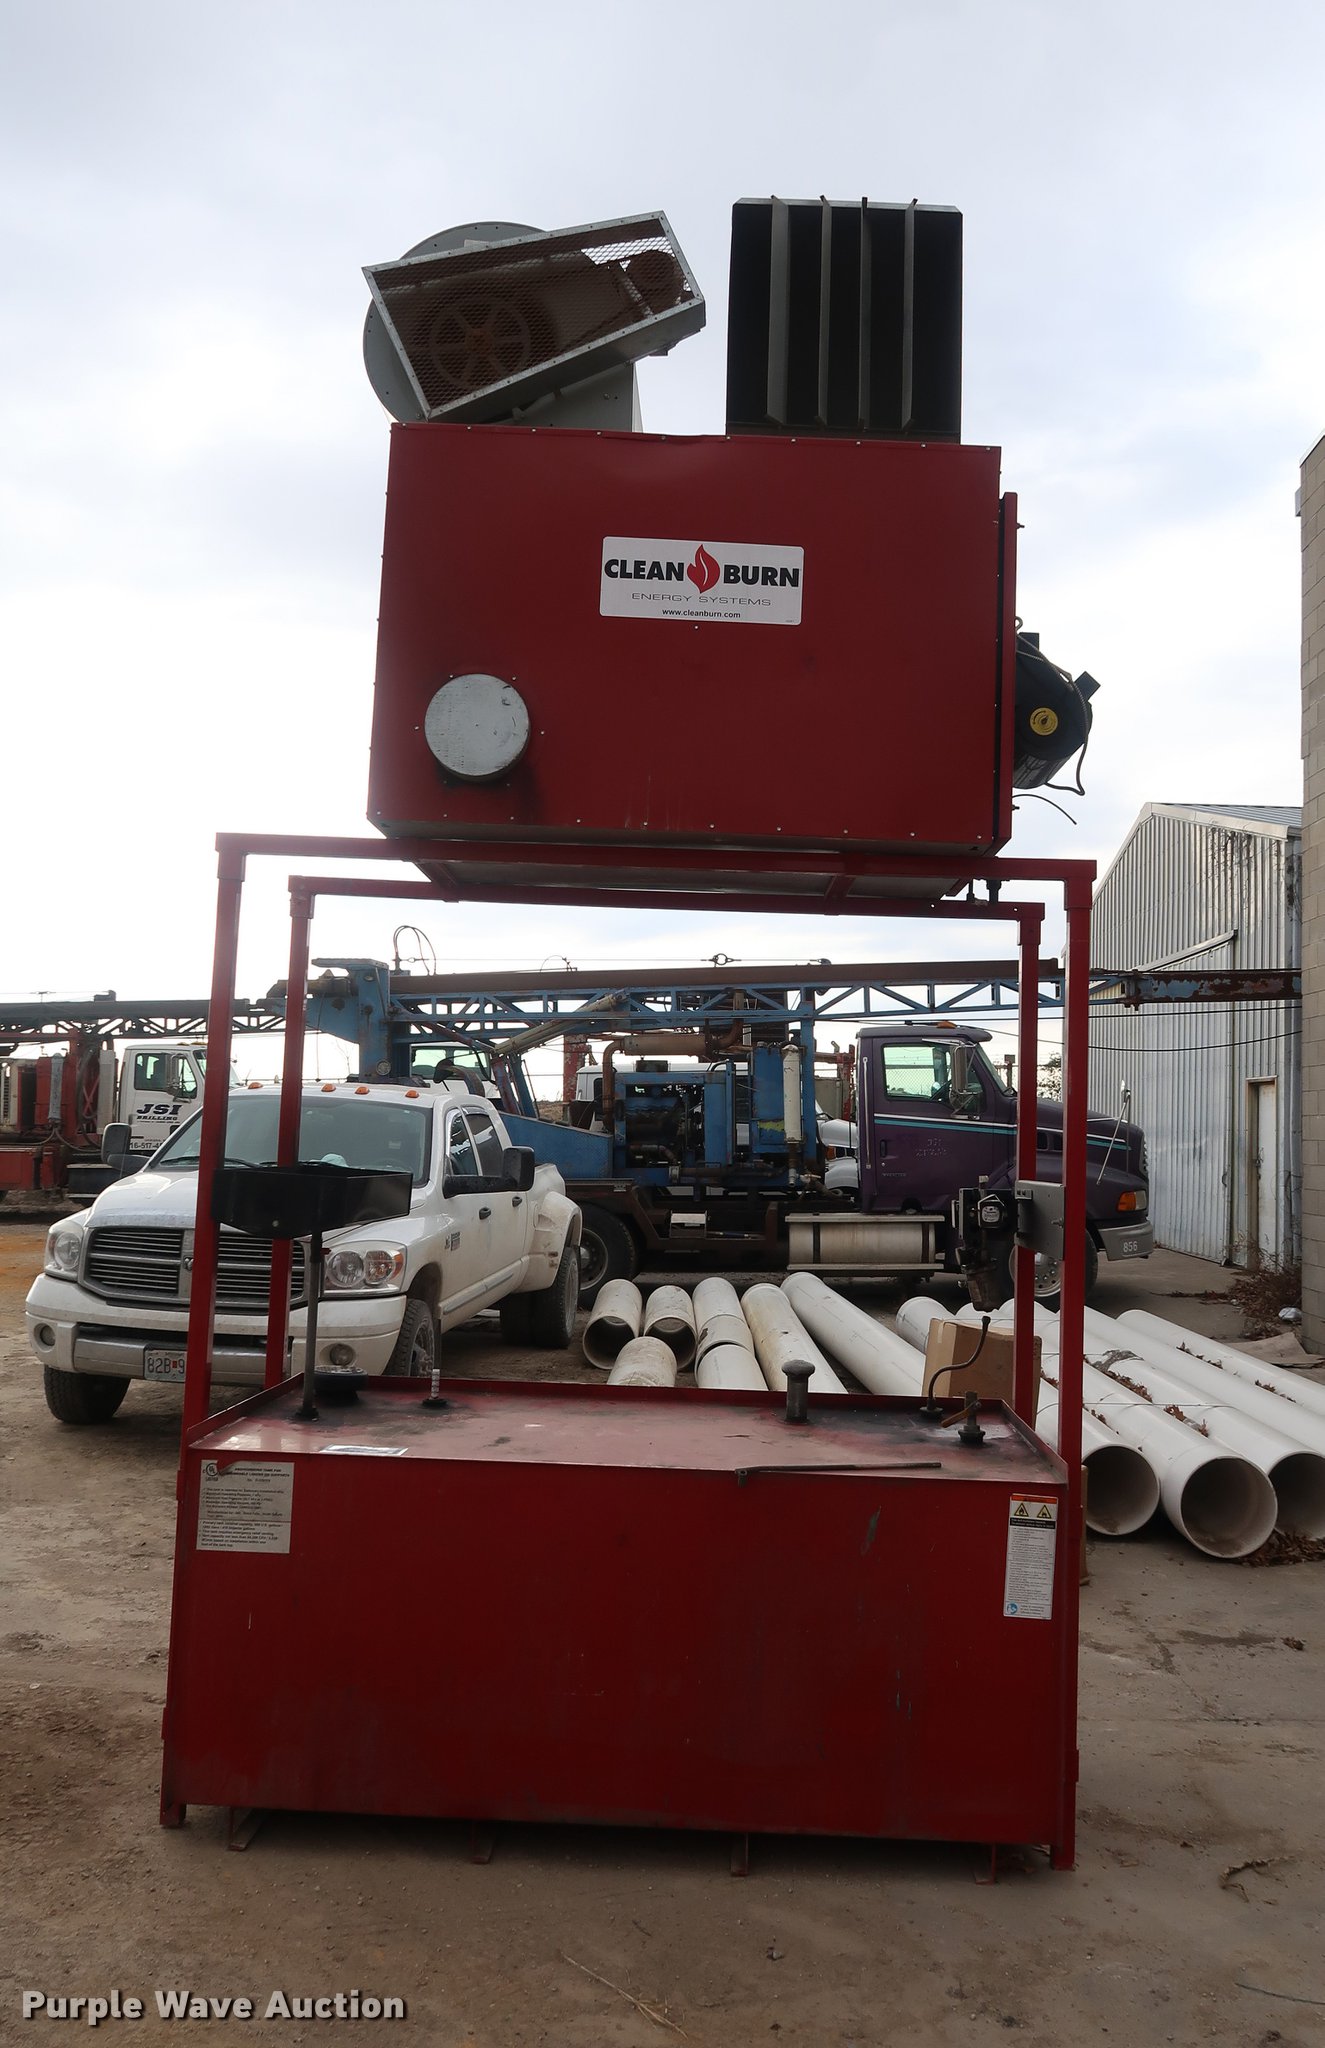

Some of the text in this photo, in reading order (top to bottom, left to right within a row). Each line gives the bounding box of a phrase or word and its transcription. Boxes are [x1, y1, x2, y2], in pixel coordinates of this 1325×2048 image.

[604, 559, 799, 588] CLEAN BURN
[631, 592, 771, 606] ENERGY SYSTEMS
[662, 608, 741, 619] www.cleanburn.com
[136, 1104, 182, 1115] JSI
[1123, 1240, 1138, 1253] 856
